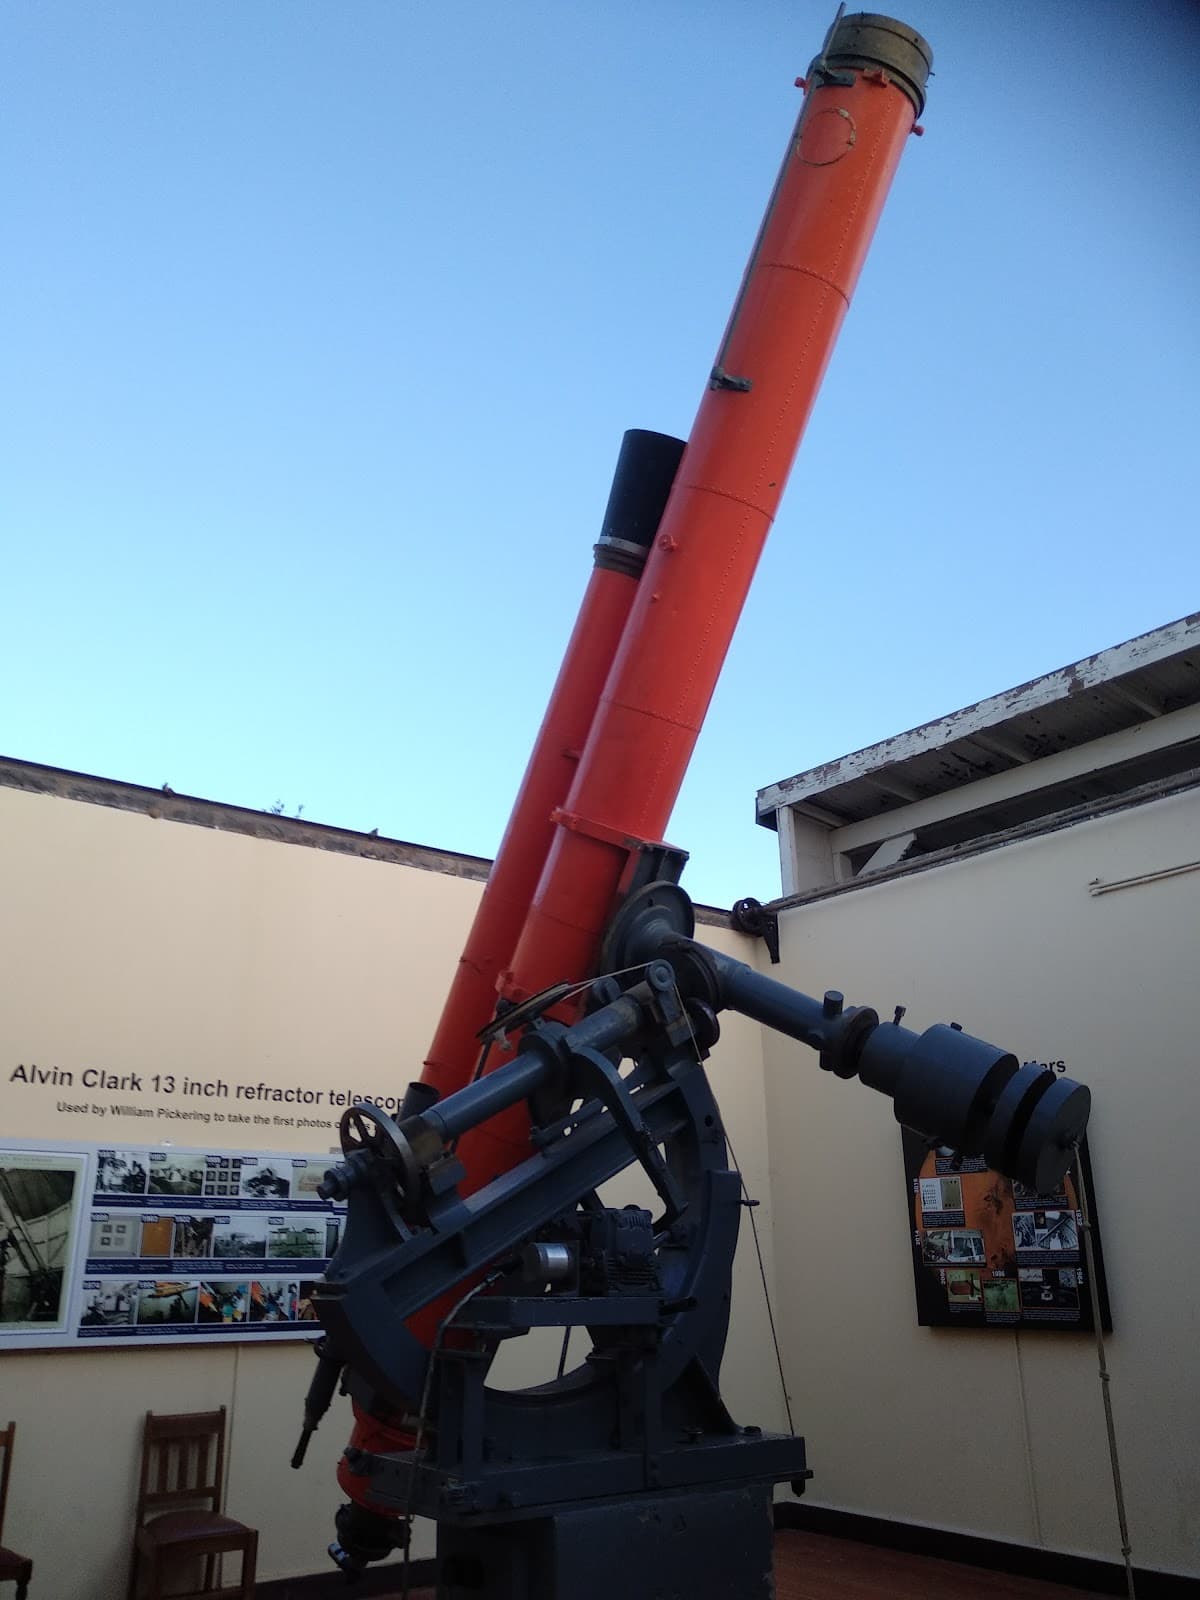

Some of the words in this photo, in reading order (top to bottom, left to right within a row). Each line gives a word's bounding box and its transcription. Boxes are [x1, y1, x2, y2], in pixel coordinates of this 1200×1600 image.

[1023, 1060, 1066, 1073] ars
[9, 1064, 73, 1087] Alvin
[82, 1069, 142, 1091] Clark
[151, 1074, 176, 1094] 13
[183, 1077, 228, 1098] inch
[236, 1083, 324, 1105] refractor
[56, 1101, 88, 1114] Used
[92, 1104, 107, 1117] by
[110, 1105, 154, 1119] William
[156, 1108, 211, 1123] Pickering
[214, 1112, 225, 1123] to
[228, 1113, 250, 1124] take
[254, 1115, 270, 1126] the
[273, 1116, 294, 1127] first
[296, 1118, 332, 1130] photos
